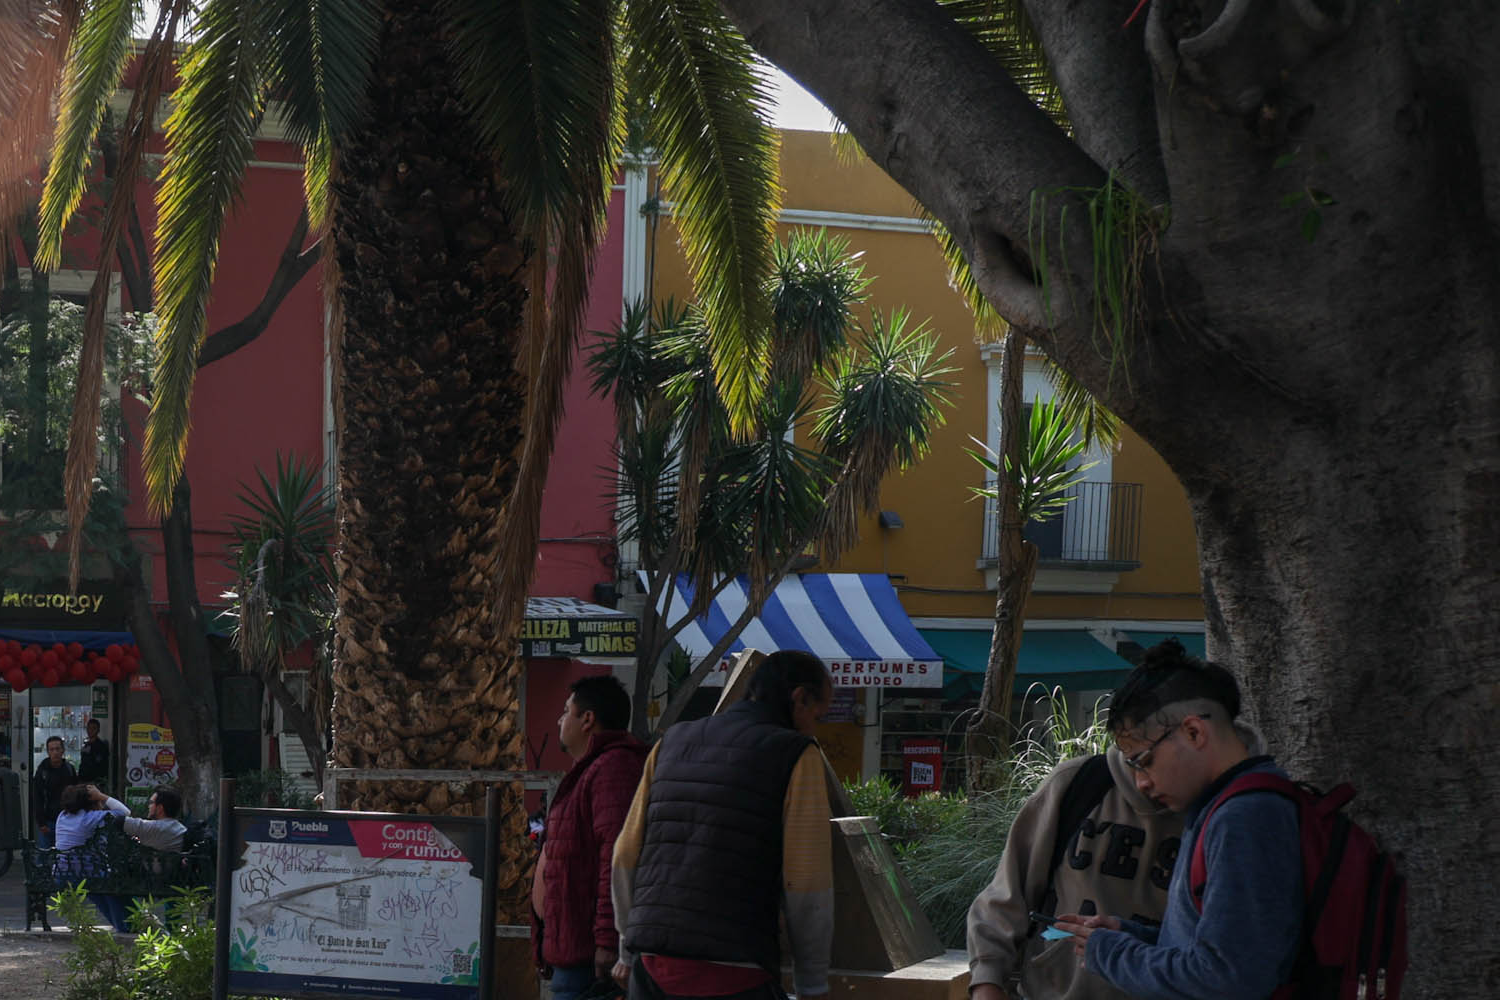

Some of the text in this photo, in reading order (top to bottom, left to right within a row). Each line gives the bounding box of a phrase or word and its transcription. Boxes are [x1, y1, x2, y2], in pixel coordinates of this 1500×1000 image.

[578, 621, 623, 633] MATERIAL
[624, 621, 637, 633] DE
[584, 633, 637, 653] UÑAS
[831, 662, 928, 675] PERFUMES
[291, 820, 330, 833] Puebla
[381, 823, 438, 847] Contig
[388, 842, 404, 850] con
